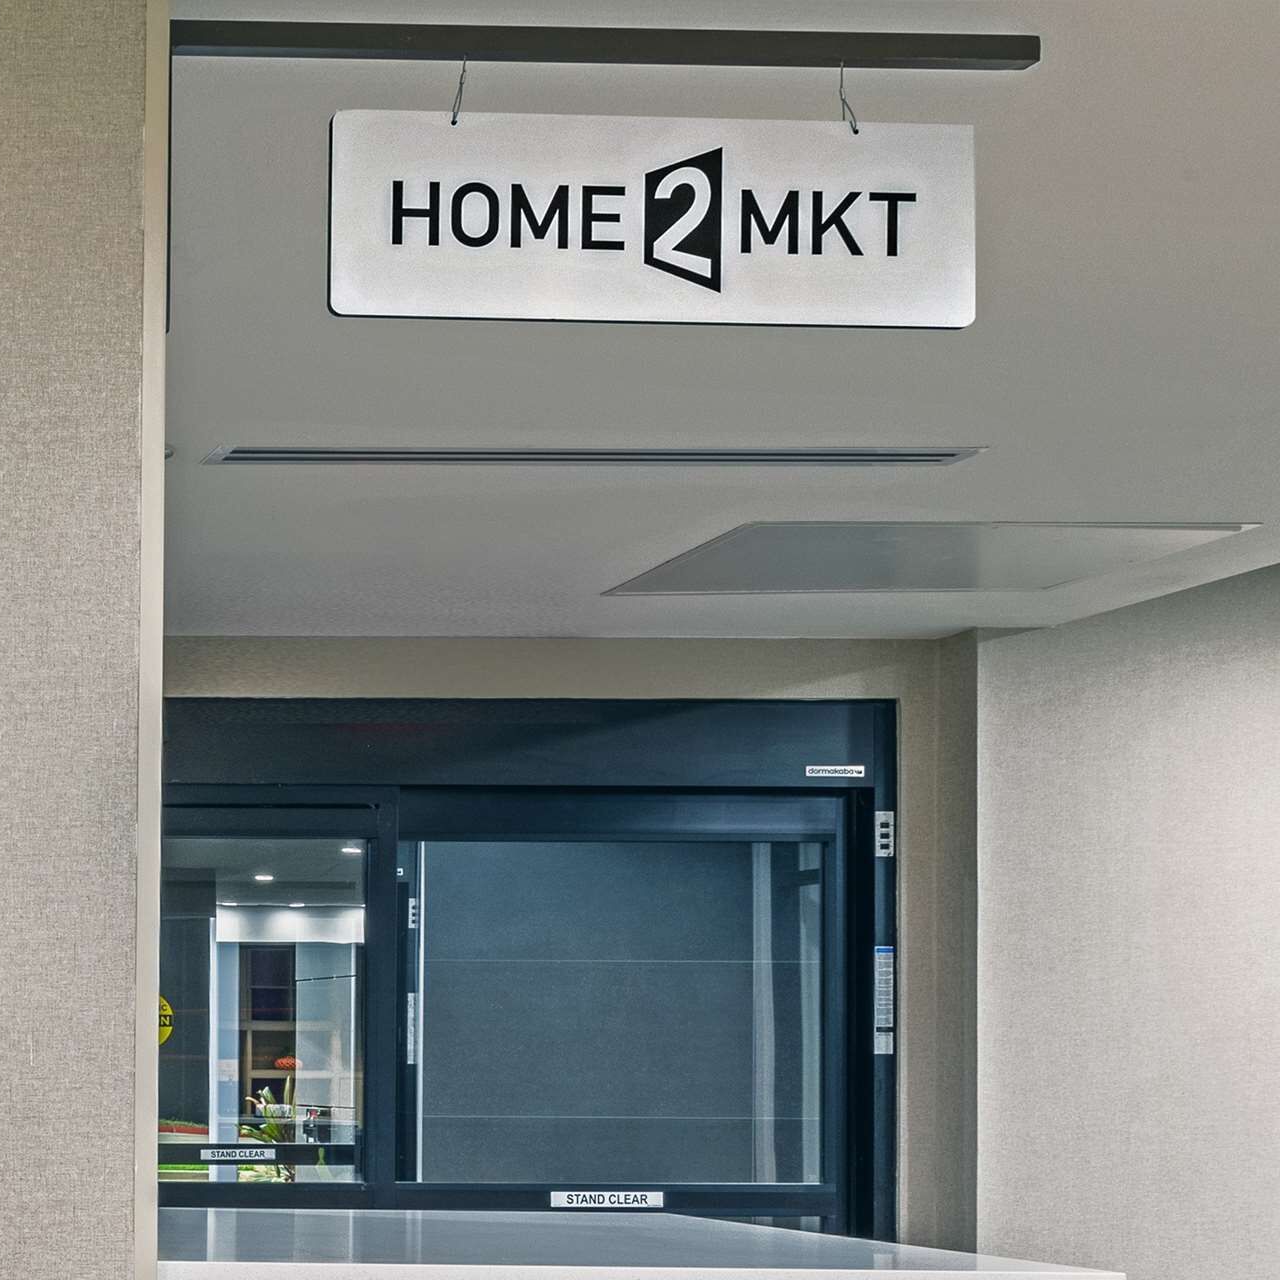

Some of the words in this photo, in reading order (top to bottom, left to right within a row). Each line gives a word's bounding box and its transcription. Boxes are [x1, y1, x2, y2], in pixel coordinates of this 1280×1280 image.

[807, 767, 854, 776] dormakaba
[210, 1149, 237, 1160] STAND
[238, 1149, 265, 1160] CLEAR
[566, 1193, 607, 1205] STAND
[608, 1193, 649, 1205] CLEAR
